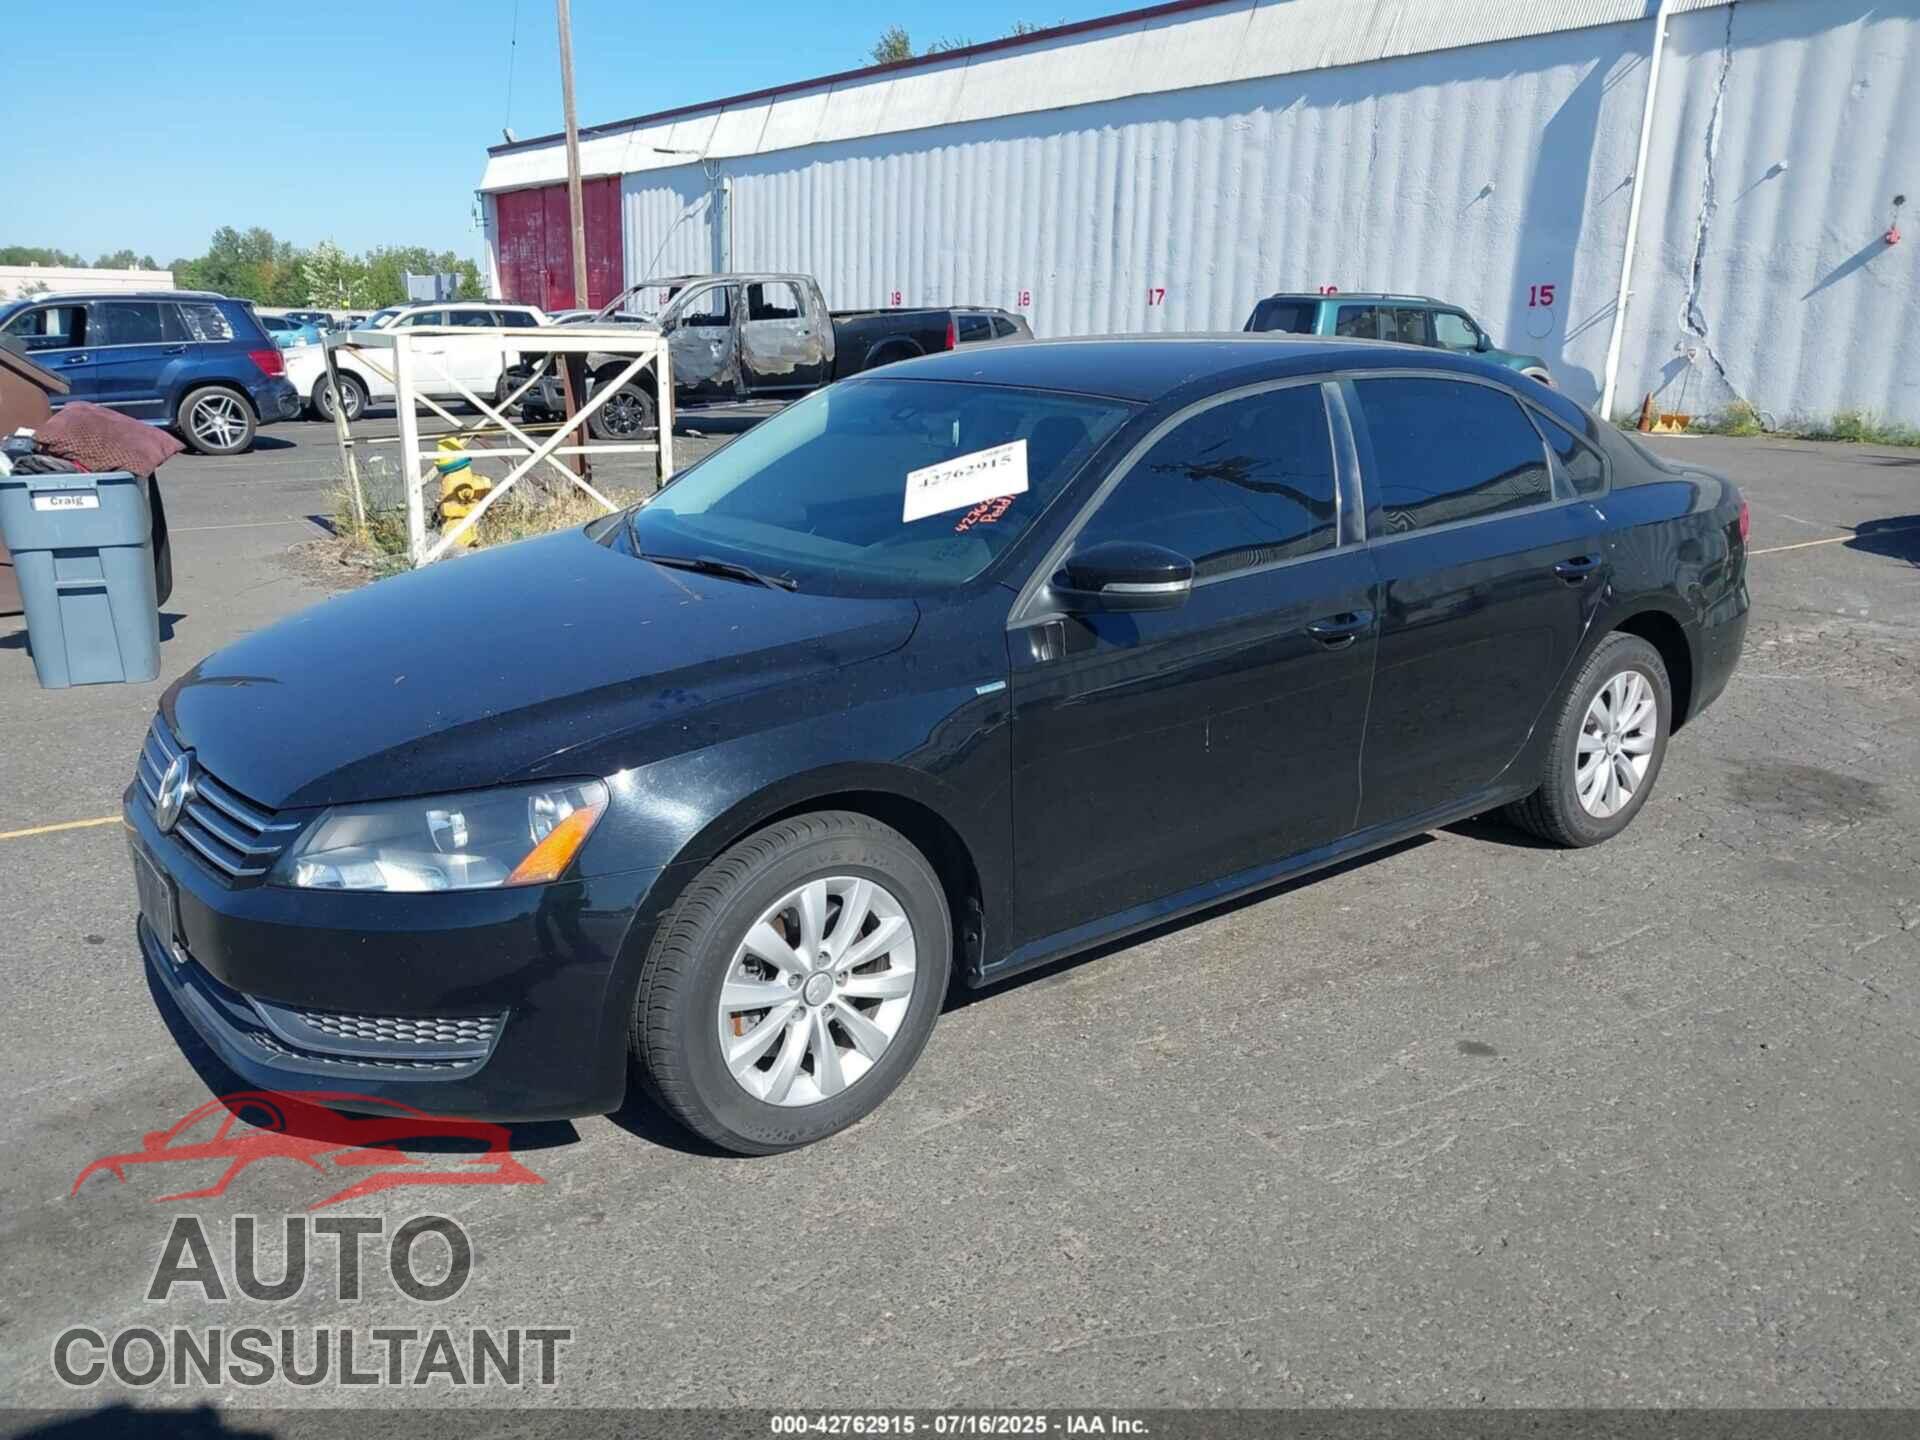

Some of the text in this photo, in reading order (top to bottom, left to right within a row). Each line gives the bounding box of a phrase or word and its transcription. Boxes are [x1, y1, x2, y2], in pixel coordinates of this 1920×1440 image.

[891, 291, 902, 306] 19
[1017, 291, 1030, 306] 18
[1147, 288, 1165, 305] 17
[1528, 285, 1555, 307] 15
[919, 455, 1012, 488] 42762915
[50, 496, 84, 506] Craig
